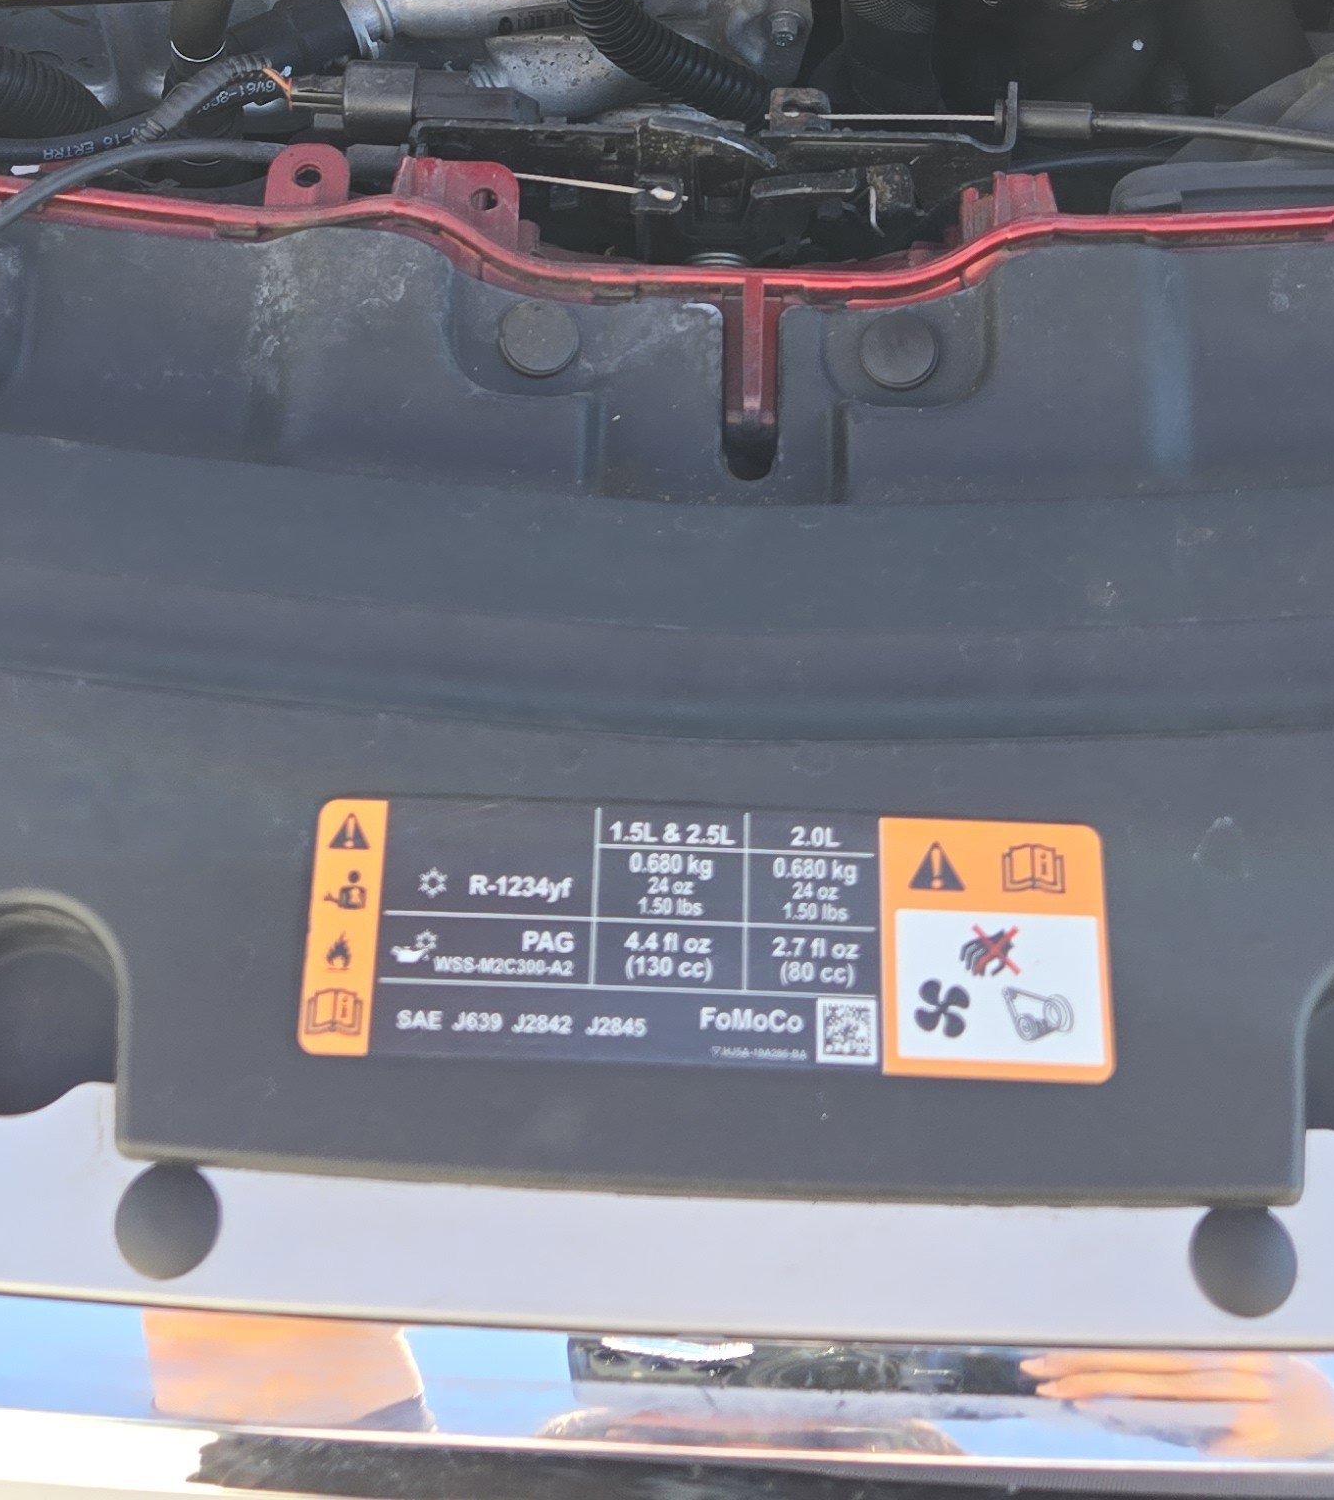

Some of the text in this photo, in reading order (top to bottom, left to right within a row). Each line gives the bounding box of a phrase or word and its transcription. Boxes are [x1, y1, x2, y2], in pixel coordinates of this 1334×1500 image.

[610, 821, 736, 845] 1.5L & 2.5L
[790, 826, 842, 847] 2.0L
[629, 852, 714, 881] 0.680 kg
[772, 857, 858, 885] 0.680 kg
[468, 874, 574, 903] R-1234yf
[647, 876, 695, 895] 24 oz
[792, 882, 839, 901] 24 oz
[638, 897, 704, 917] 1.50 lbs
[782, 902, 849, 922] 1.50 lbs
[522, 930, 575, 954] PAG
[624, 931, 713, 954] 4.4 fl oz
[771, 937, 861, 960] 2.7 fl oz
[433, 955, 574, 977] WSS-M2C300-A2
[625, 955, 714, 983] (130 cc)
[780, 960, 855, 989] (80 cc)
[396, 1009, 648, 1038] SAE J639 J2842 J2845
[699, 1005, 805, 1034] FoMoCo
